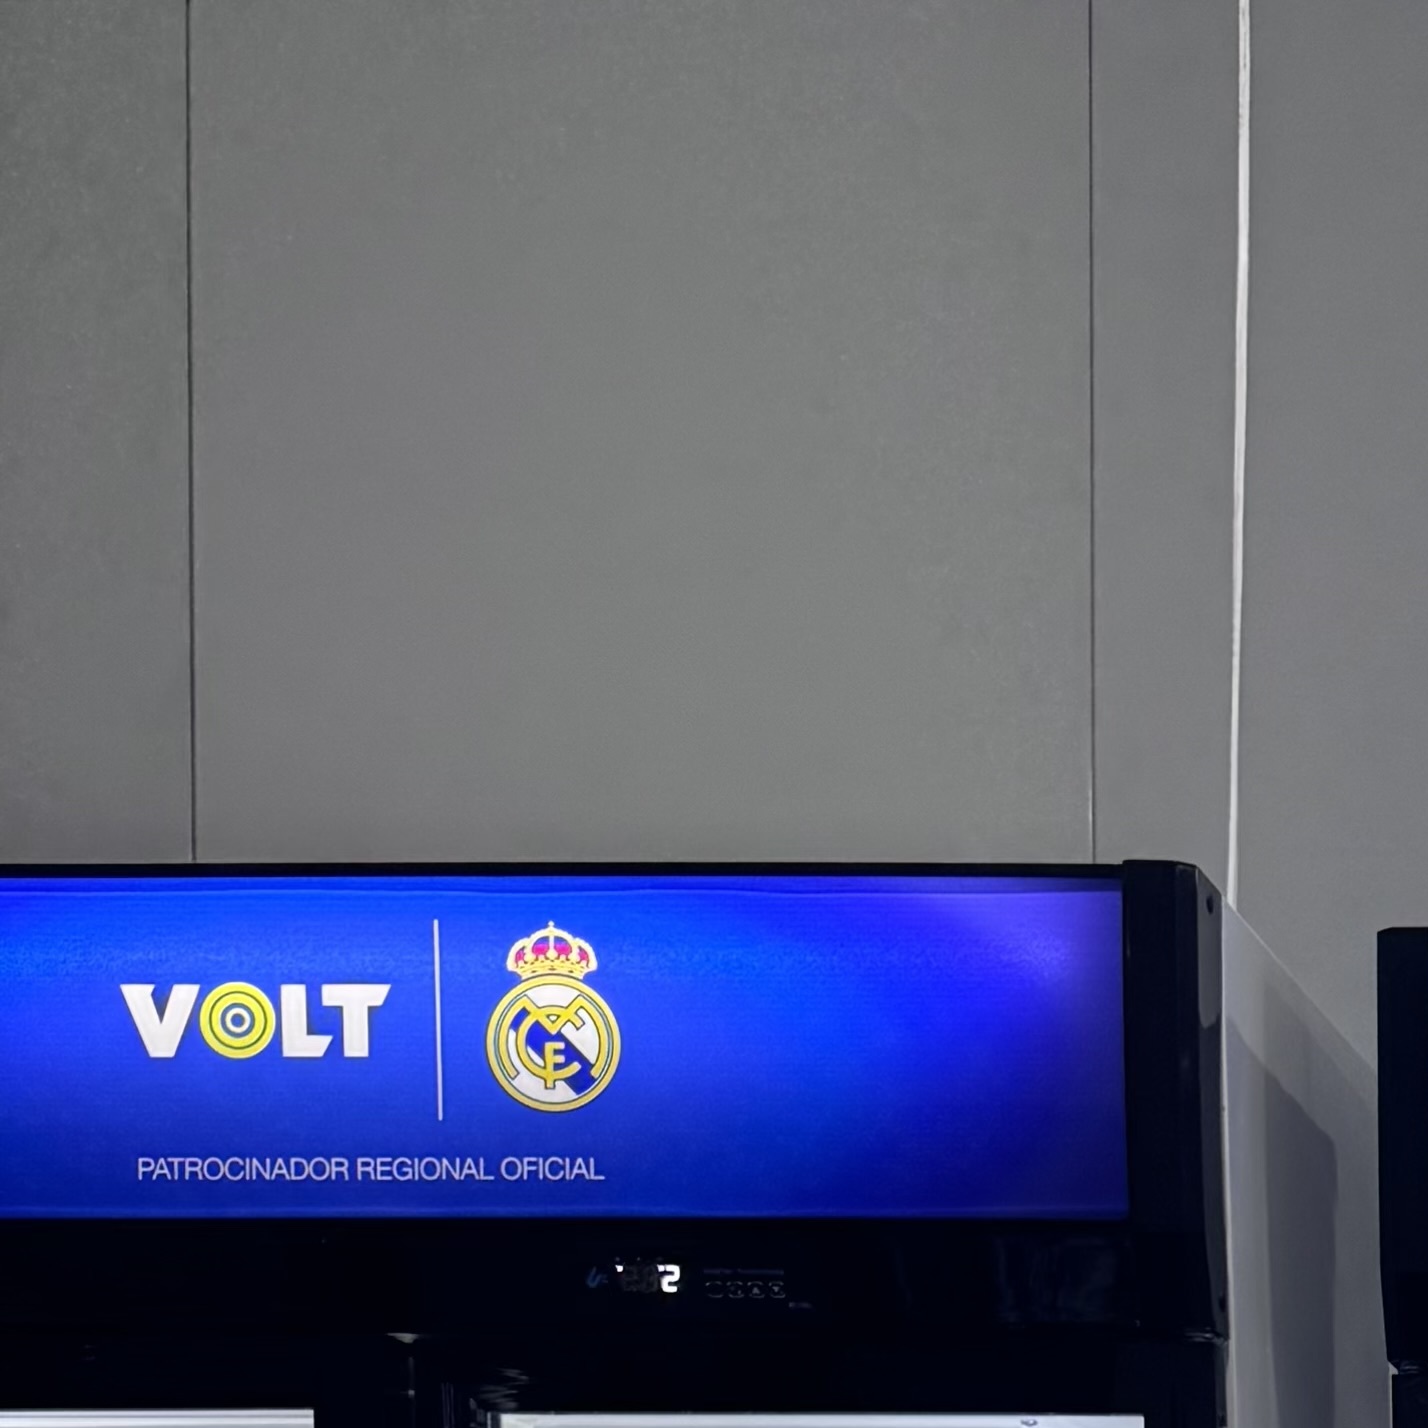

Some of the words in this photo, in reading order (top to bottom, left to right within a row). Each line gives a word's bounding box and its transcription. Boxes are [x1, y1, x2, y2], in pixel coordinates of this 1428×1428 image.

[119, 981, 392, 1060] VOLT
[137, 1156, 349, 1182] PATROCINADOR
[356, 1156, 494, 1182] REGIONAL
[500, 1156, 605, 1182] OFICIAL
